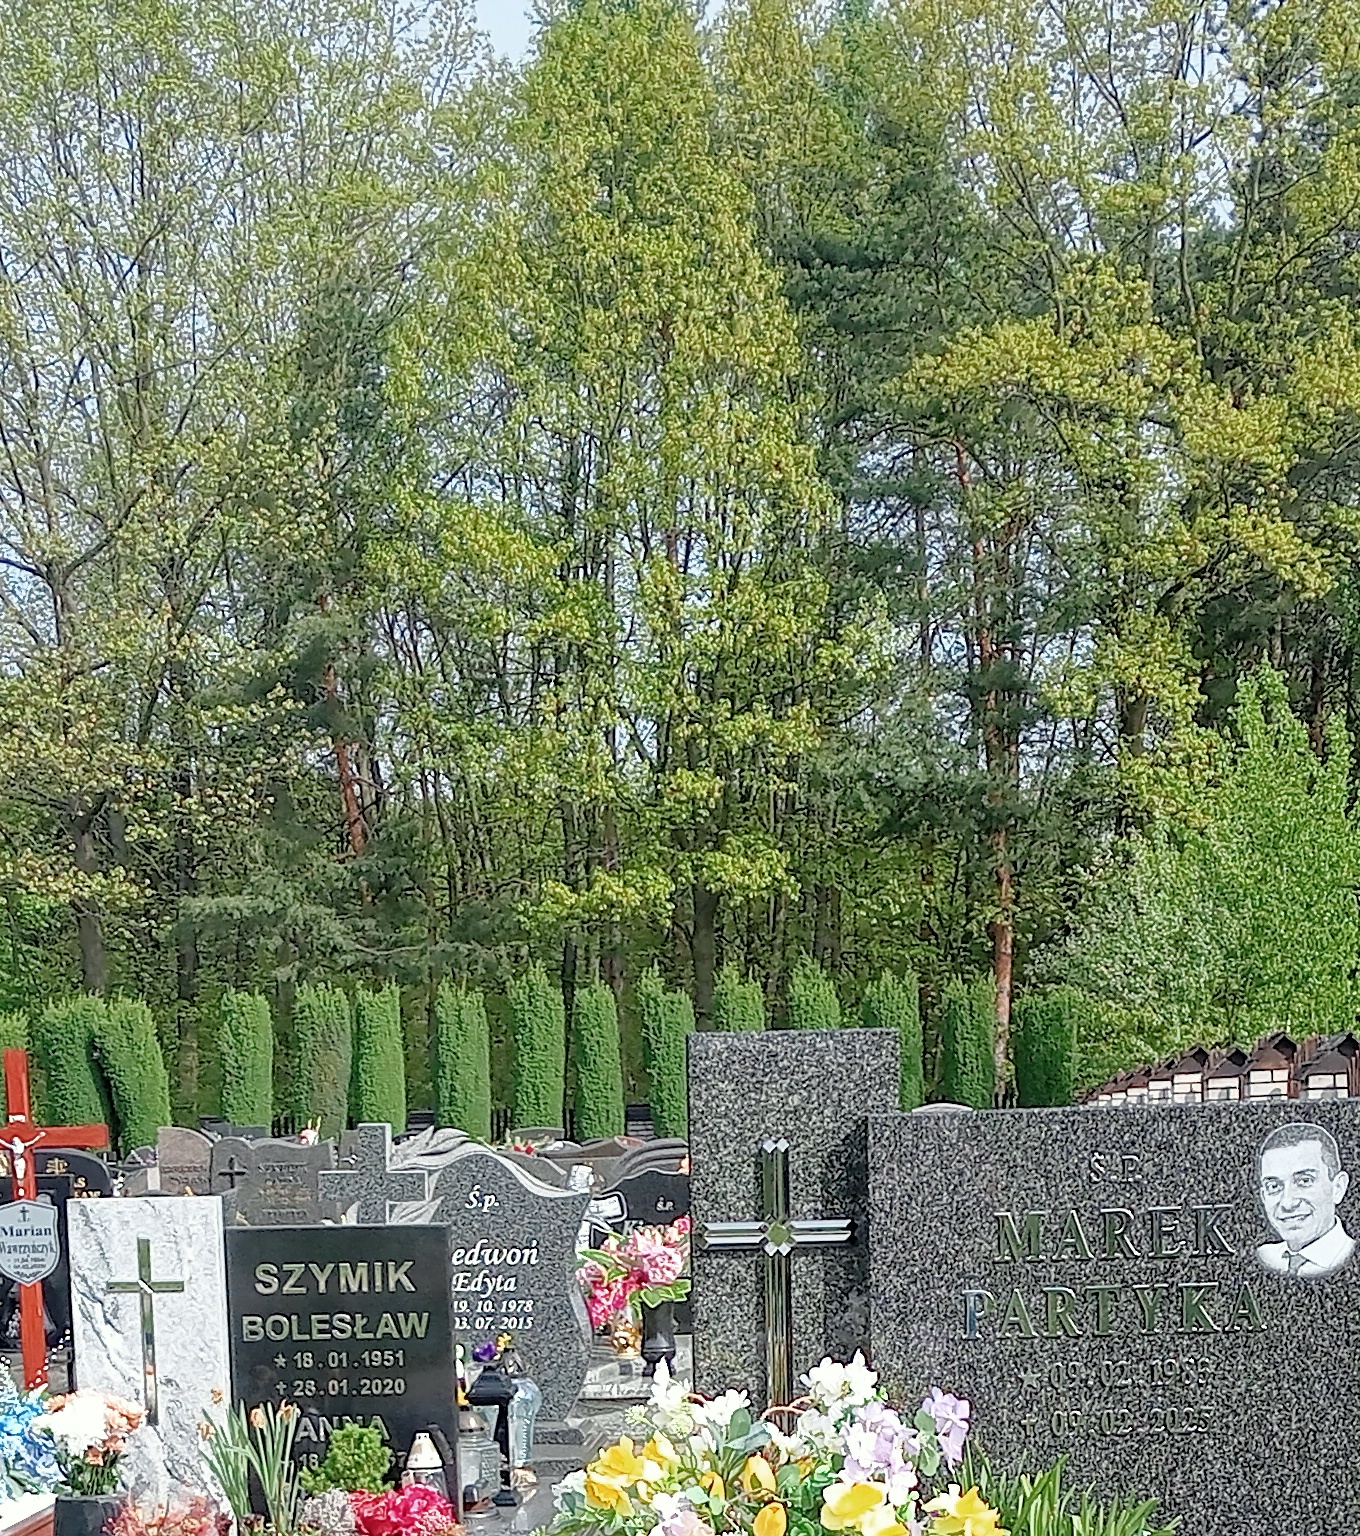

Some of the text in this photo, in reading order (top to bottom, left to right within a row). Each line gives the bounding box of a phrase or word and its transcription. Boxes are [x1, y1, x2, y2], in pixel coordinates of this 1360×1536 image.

[465, 1184, 500, 1213] Ś.p.
[0, 1225, 52, 1237] Marian
[993, 1203, 1237, 1262] MAREK
[451, 1238, 540, 1266] edwoń
[254, 1261, 417, 1295] SZYMIK
[452, 1270, 518, 1298] Edyta
[500, 1299, 534, 1313] 1978
[961, 1281, 1269, 1341] PARTYKA
[241, 1312, 430, 1343] BOLESŁAW
[499, 1316, 534, 1330] 2015
[293, 1350, 406, 1369] 18.01.1951
[293, 1378, 407, 1397] 28.01.2020
